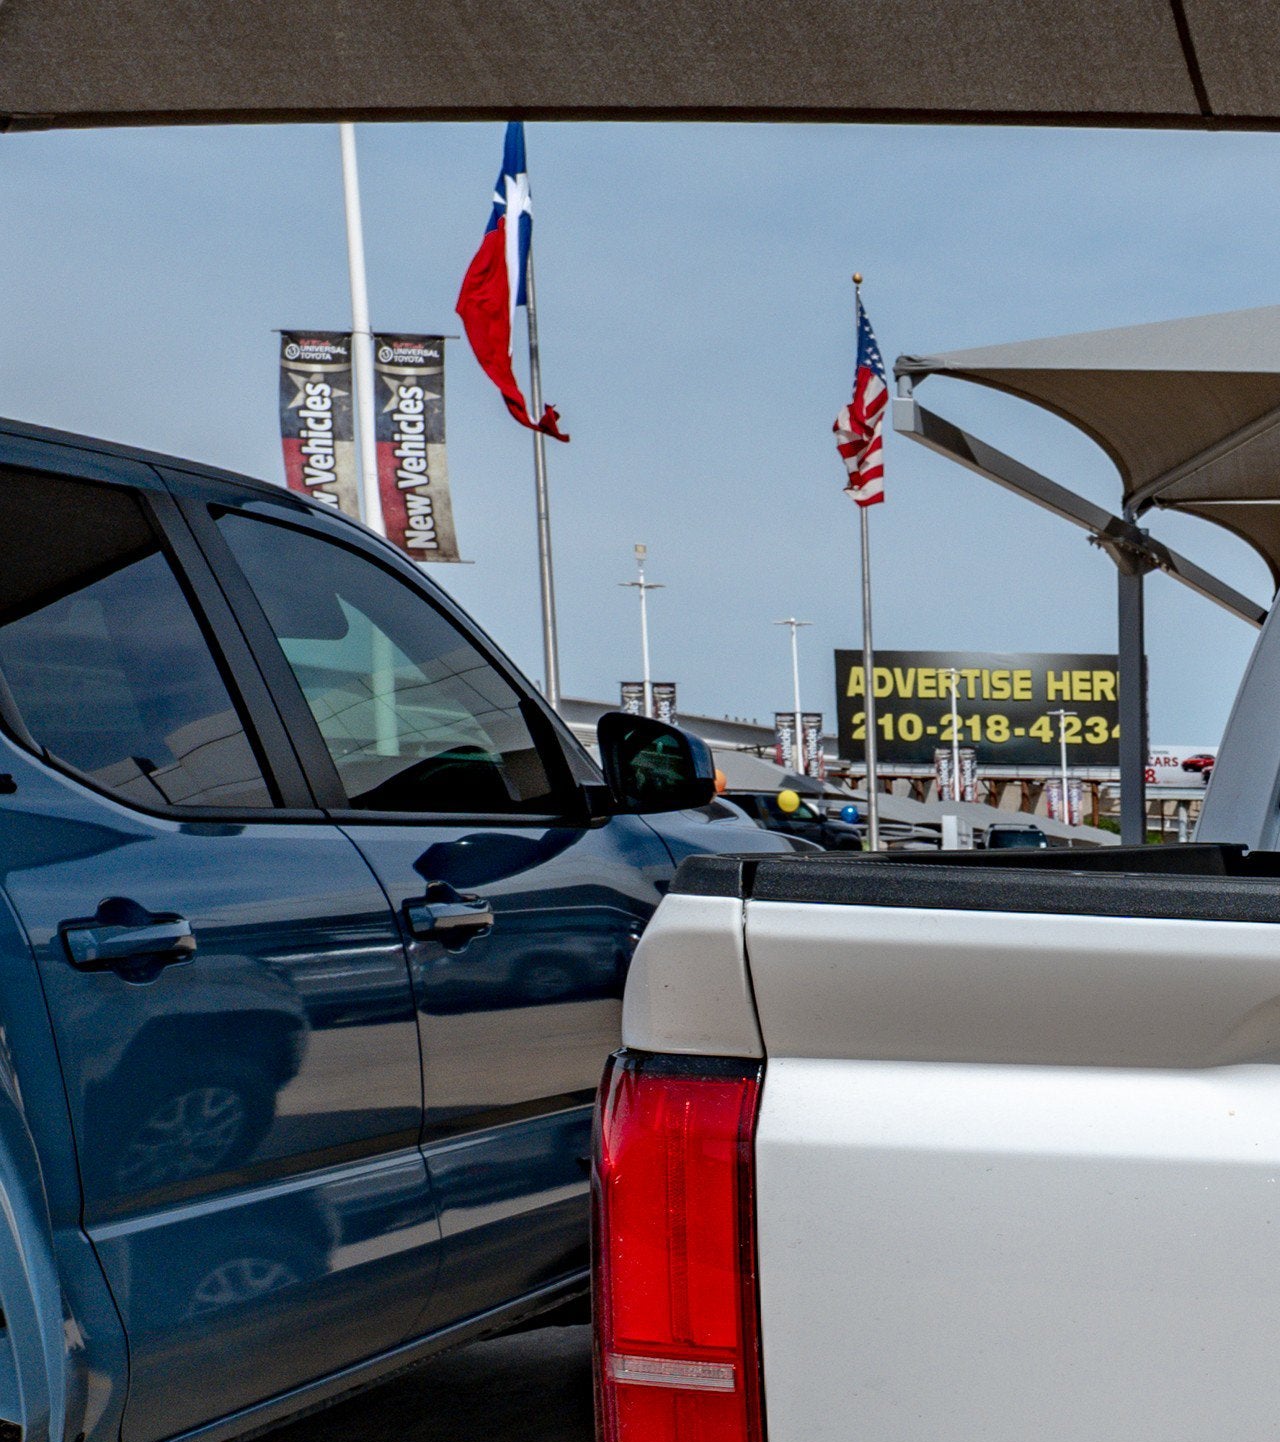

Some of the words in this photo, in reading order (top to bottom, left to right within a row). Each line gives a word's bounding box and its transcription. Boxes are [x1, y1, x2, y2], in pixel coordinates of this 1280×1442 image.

[300, 345, 348, 355] UNIVERSAL
[301, 352, 333, 360] TOYOTA
[394, 347, 440, 358] UNIVERSAL
[394, 355, 425, 364] TOYOTA
[299, 382, 337, 486] Vehicles
[393, 385, 429, 489] Vehicles
[405, 493, 438, 549] New
[846, 665, 1033, 699] ADVERTISE
[1046, 670, 1120, 701] HER
